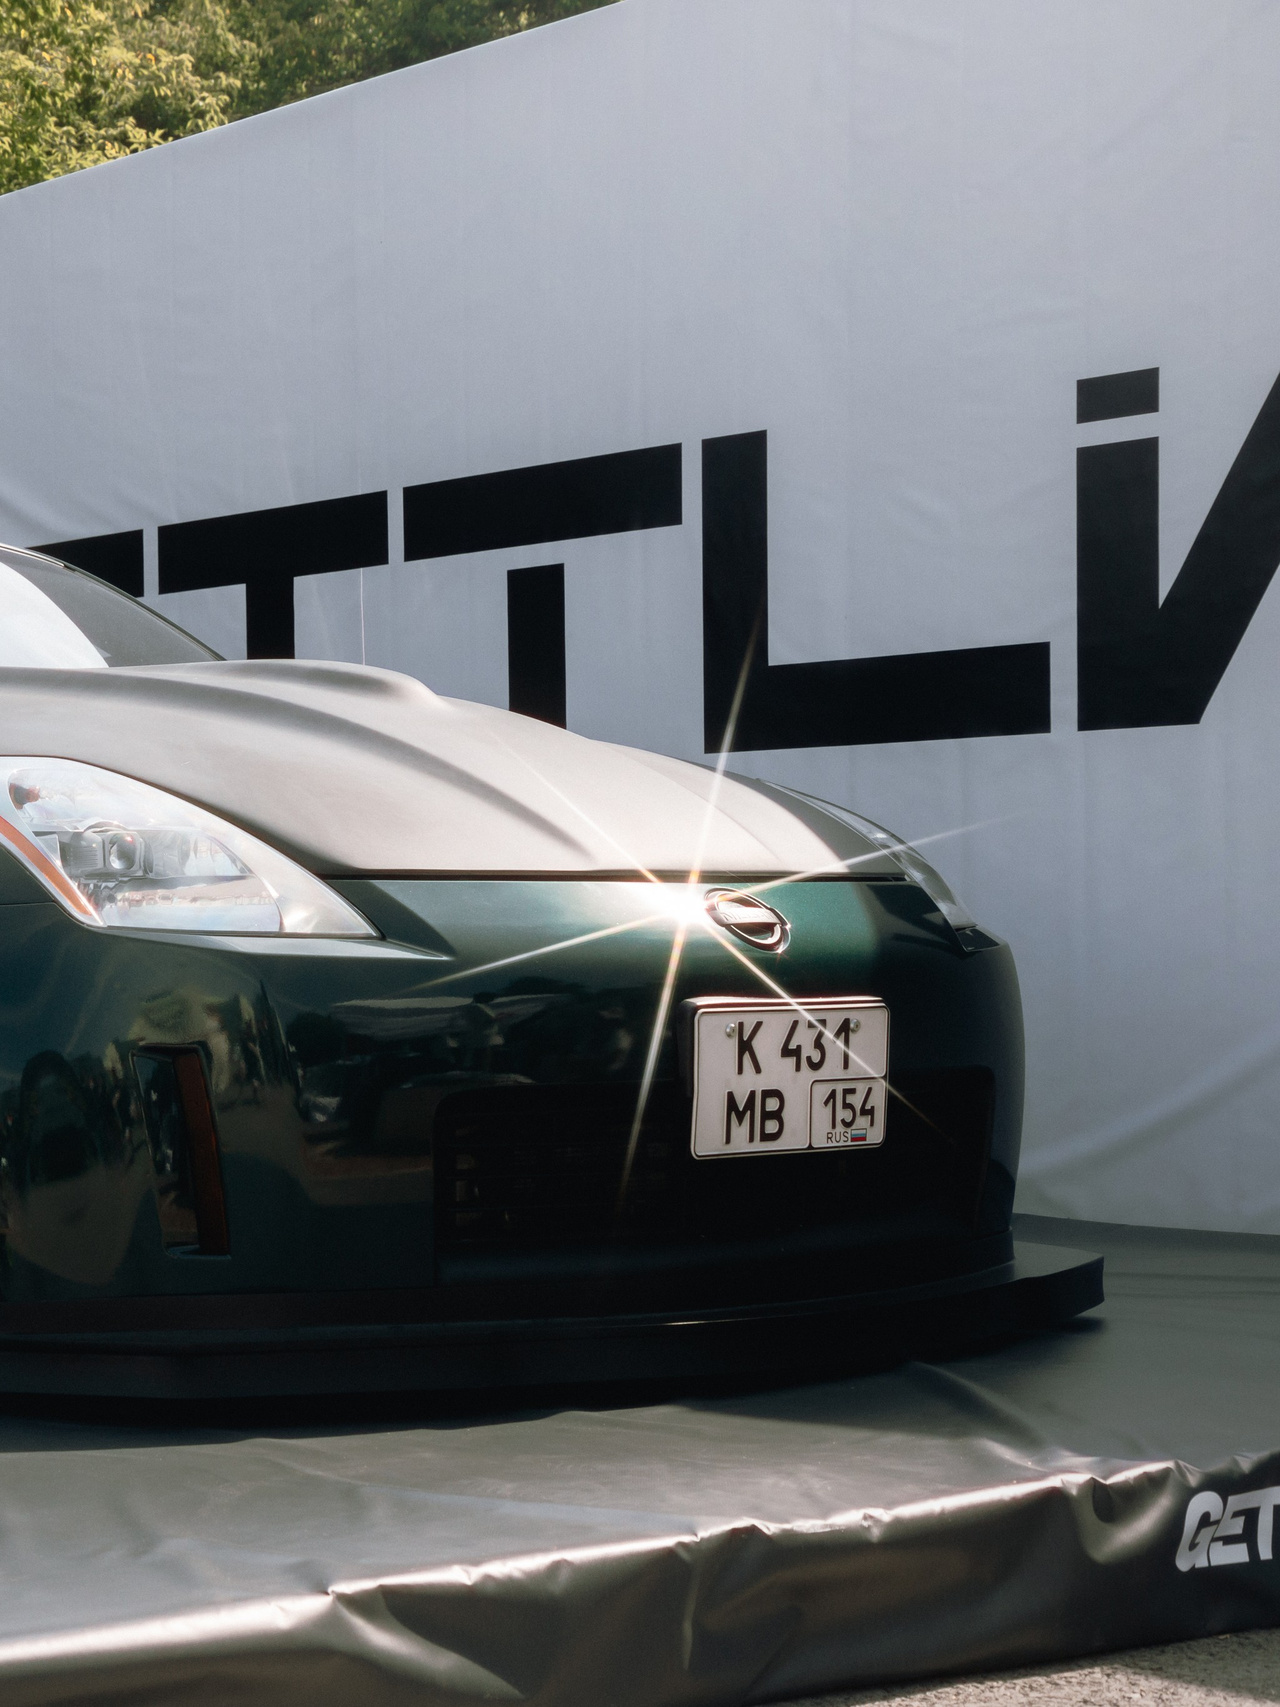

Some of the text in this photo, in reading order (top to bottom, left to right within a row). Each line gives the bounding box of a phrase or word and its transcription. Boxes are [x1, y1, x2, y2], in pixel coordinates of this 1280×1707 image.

[737, 1017, 851, 1075] K 431
[724, 1088, 785, 1145] MB
[823, 1086, 875, 1129] 154
[826, 1131, 849, 1143] RUS
